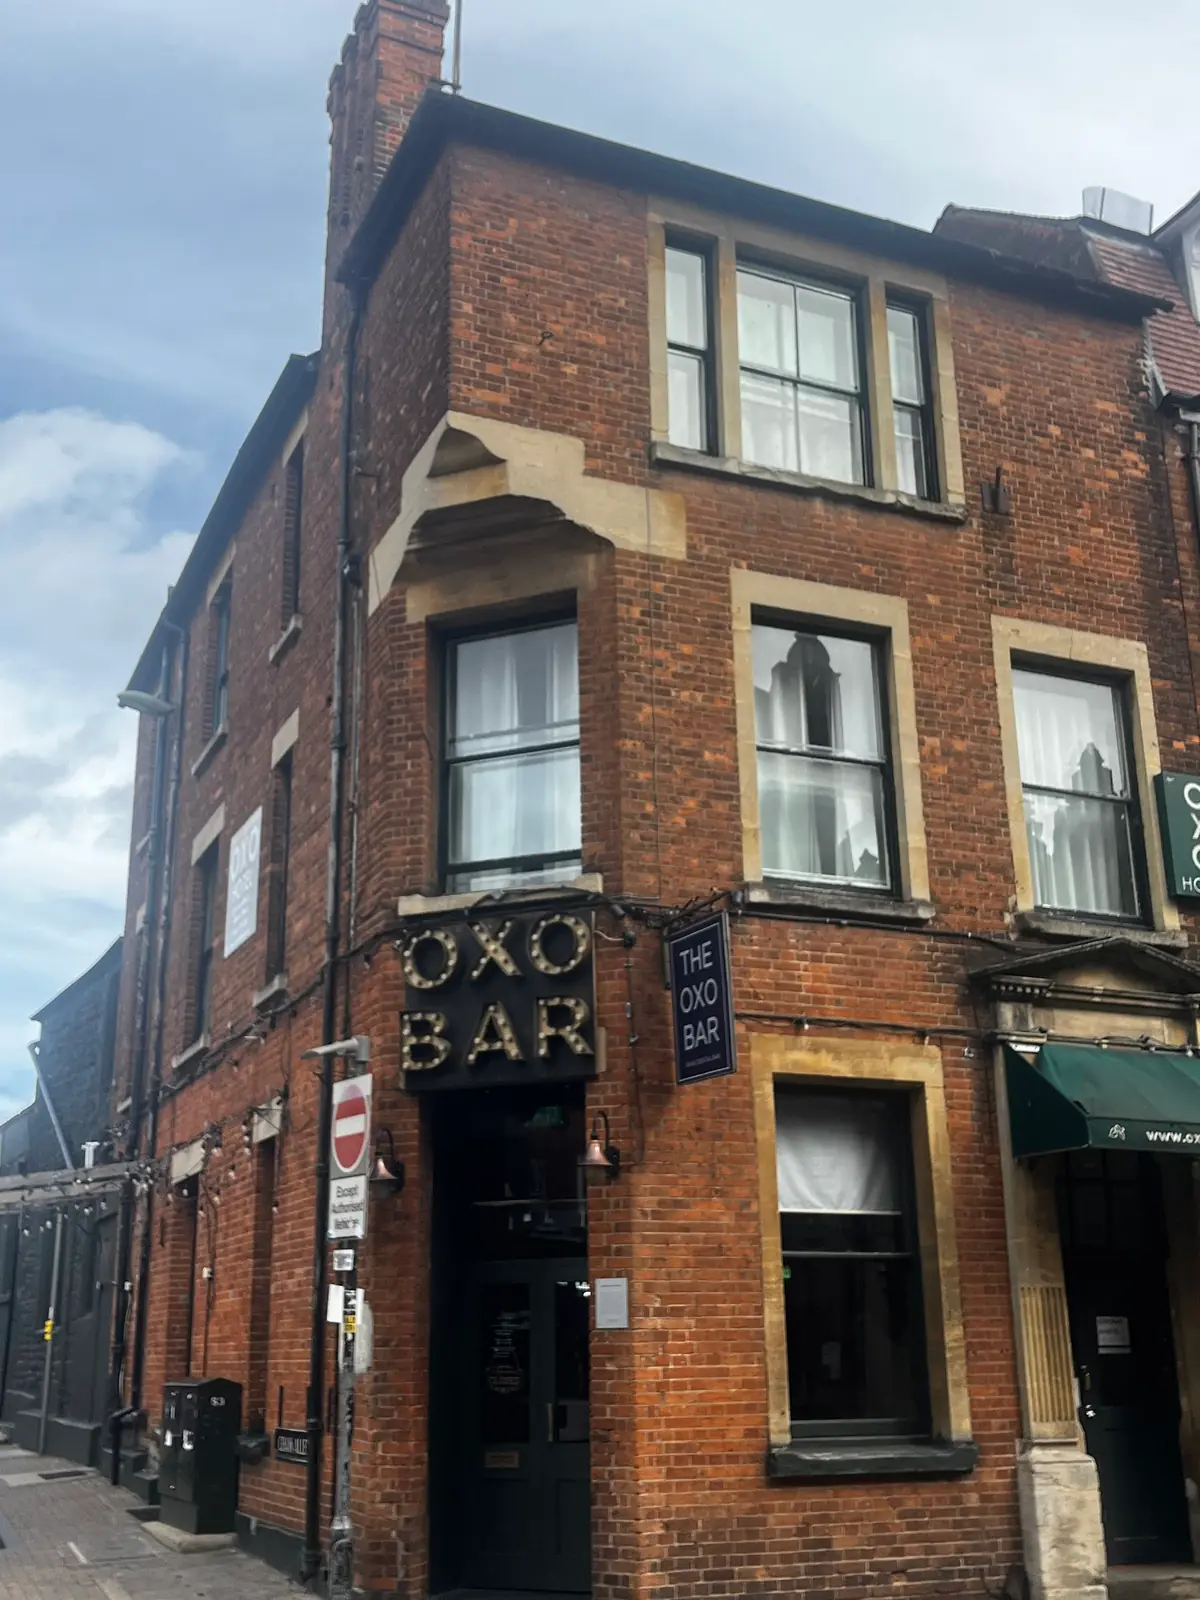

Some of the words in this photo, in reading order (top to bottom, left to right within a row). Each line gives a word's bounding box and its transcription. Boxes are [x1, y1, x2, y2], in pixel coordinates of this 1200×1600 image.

[402, 913, 589, 990] OXO
[679, 940, 714, 976] THE
[679, 978, 719, 1014] OXO
[402, 997, 594, 1071] BAR
[683, 1016, 721, 1051] BAR
